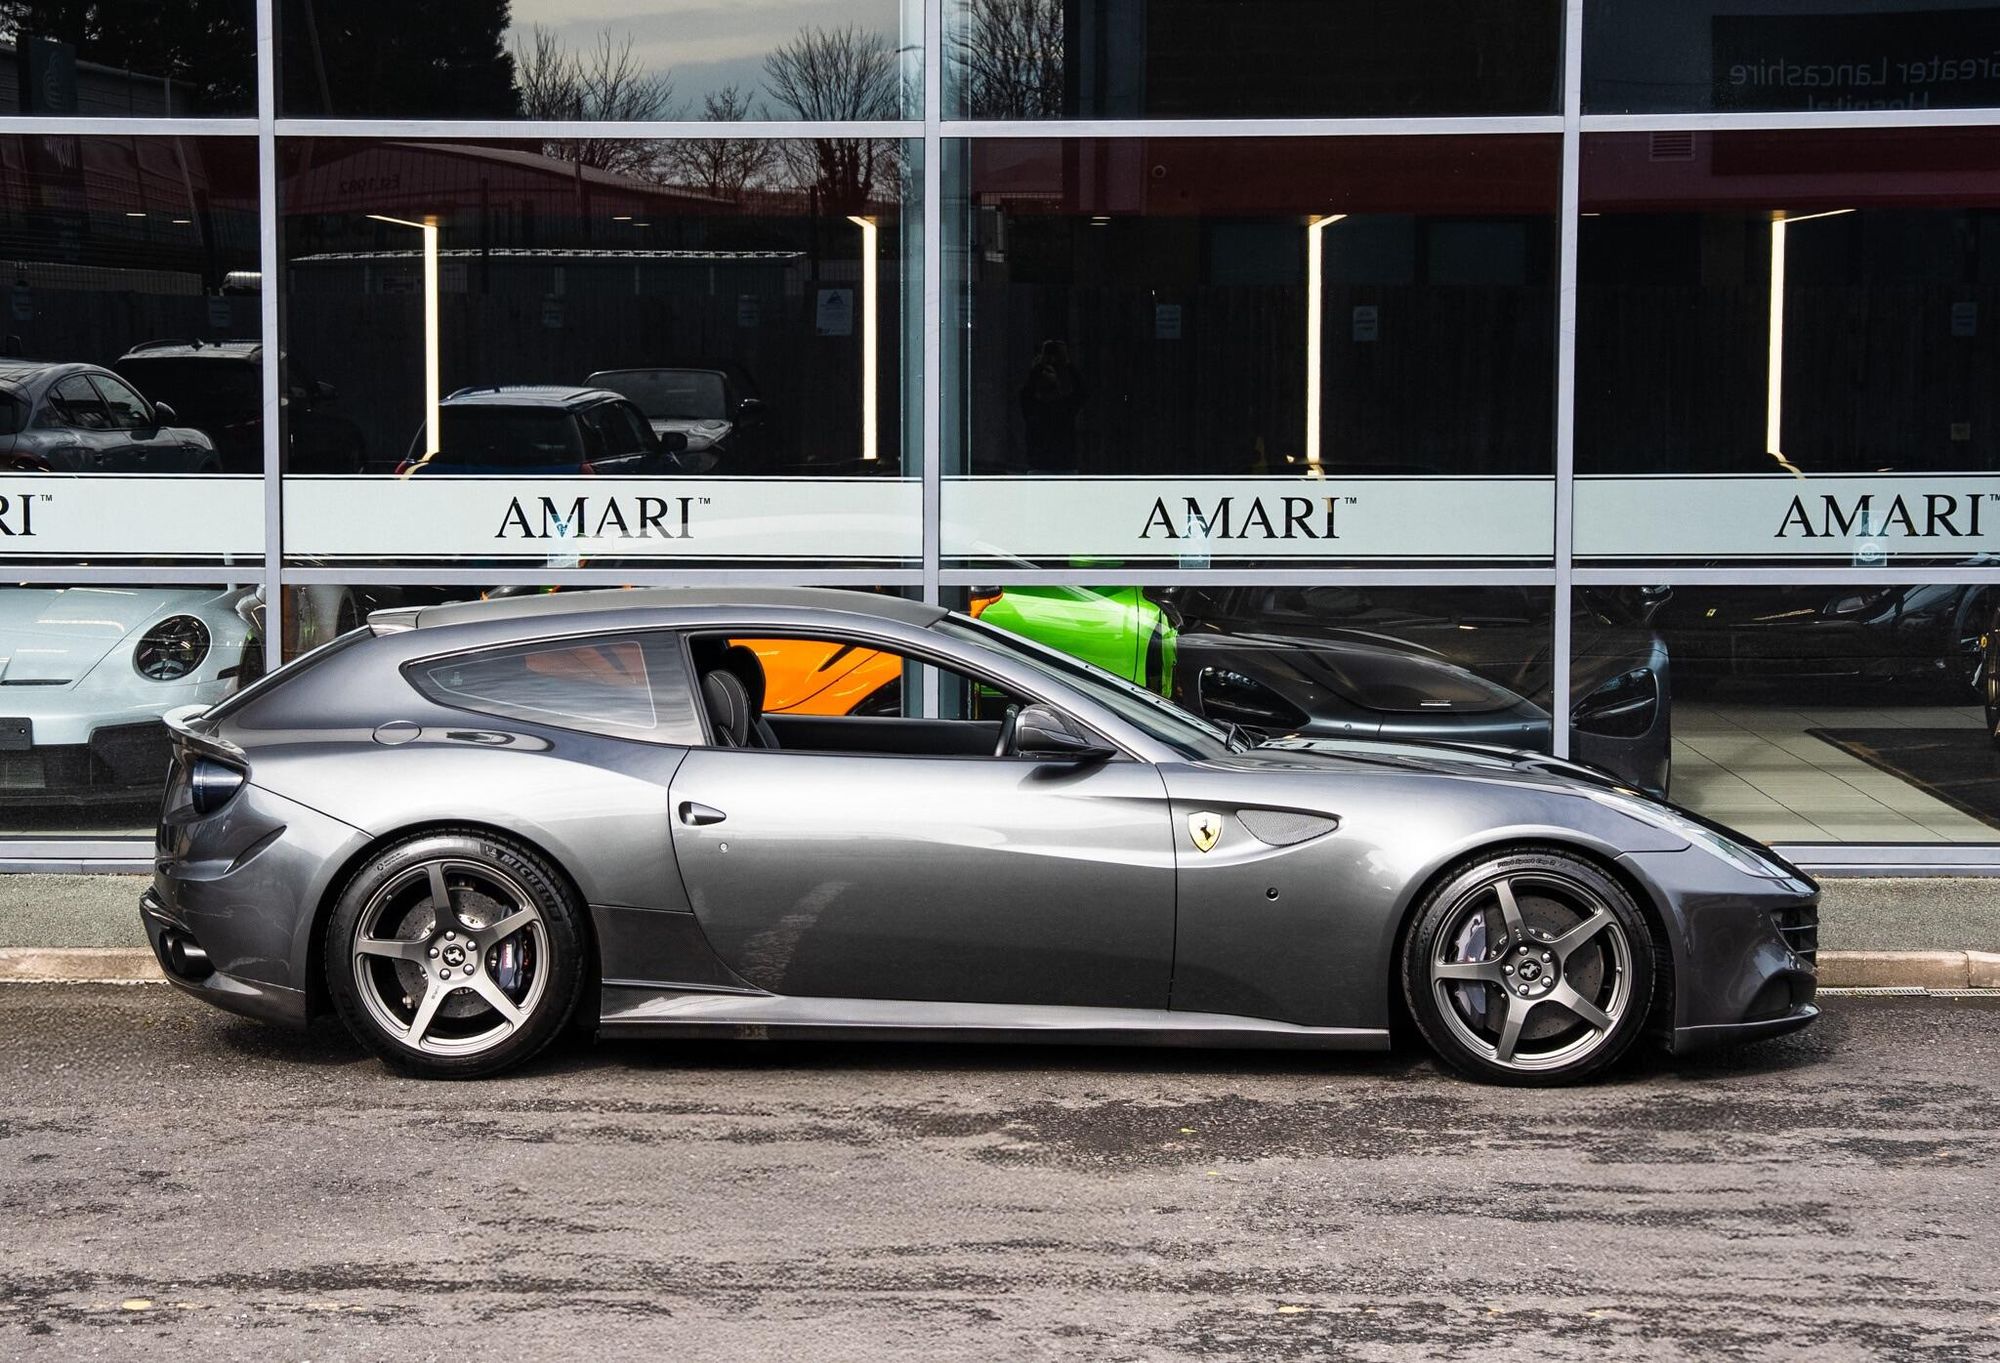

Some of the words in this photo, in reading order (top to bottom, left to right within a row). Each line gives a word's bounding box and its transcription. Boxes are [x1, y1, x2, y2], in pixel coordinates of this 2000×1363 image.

[494, 496, 694, 538] AMARI
[1138, 496, 1340, 539] AMARI
[1773, 493, 1985, 538] AMARI
[501, 854, 563, 920] MICHELIN
